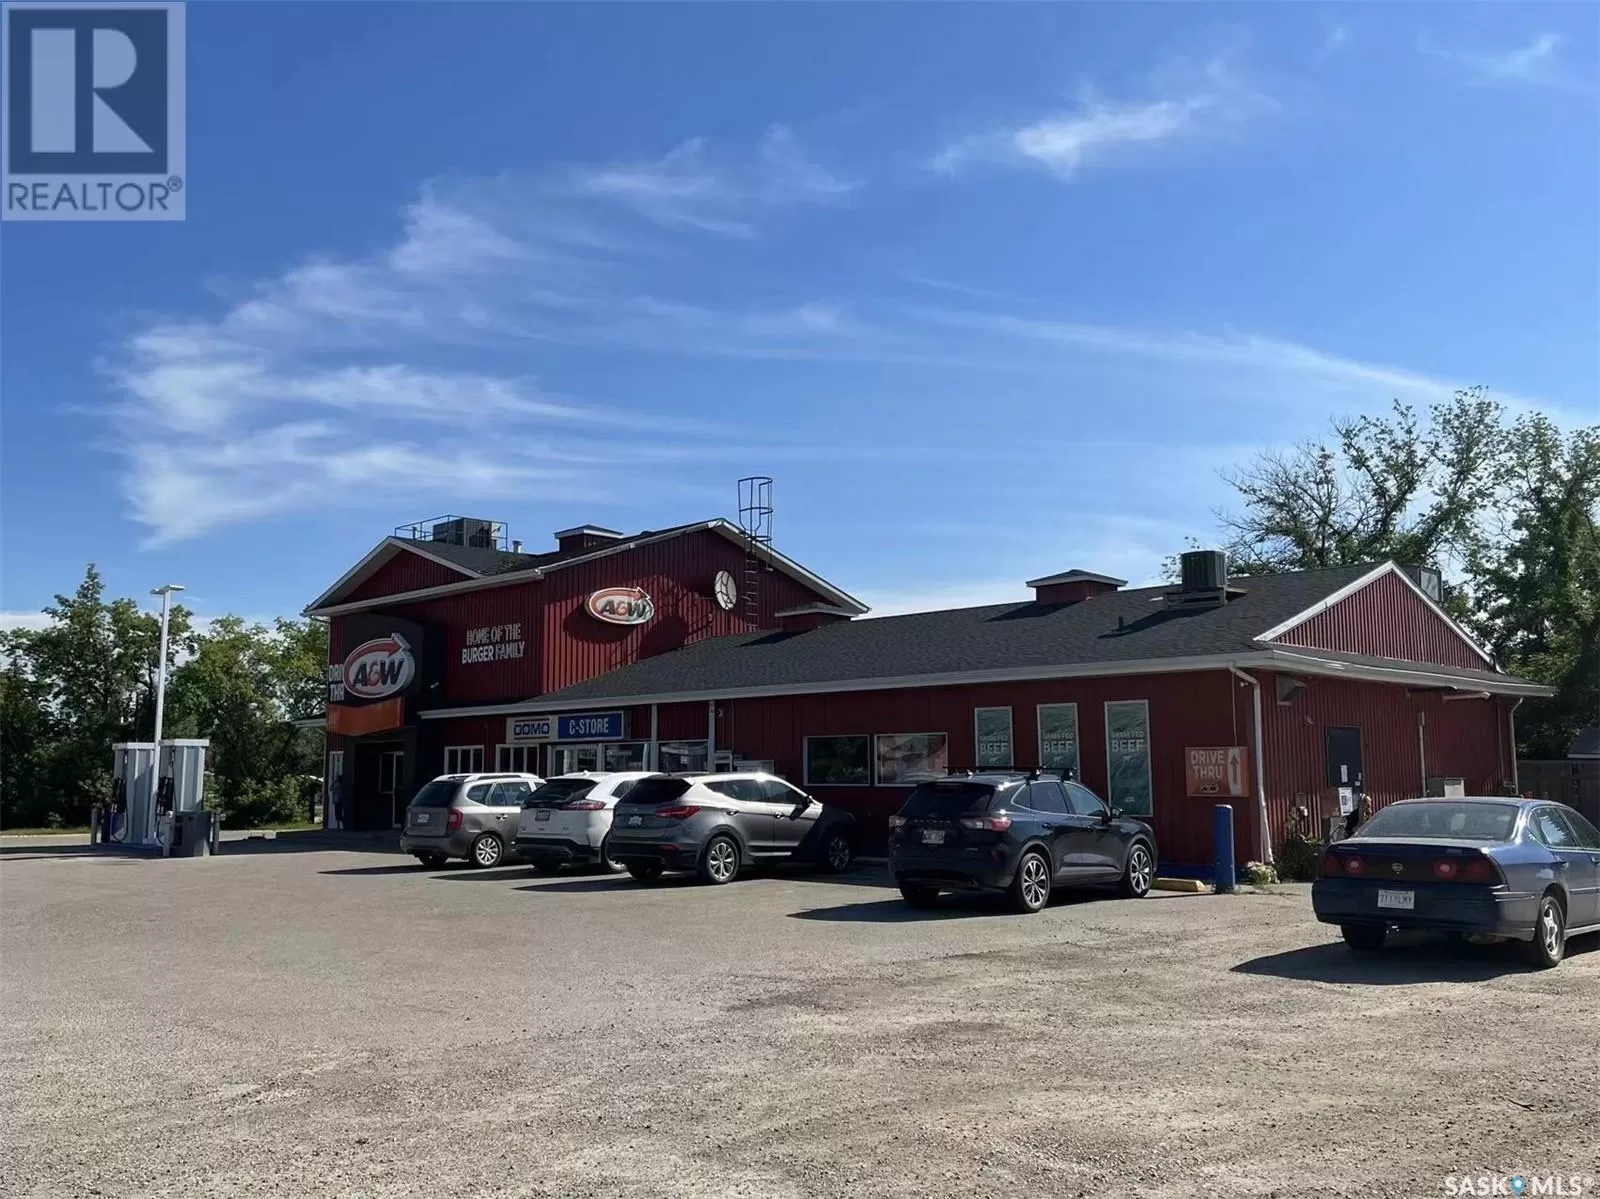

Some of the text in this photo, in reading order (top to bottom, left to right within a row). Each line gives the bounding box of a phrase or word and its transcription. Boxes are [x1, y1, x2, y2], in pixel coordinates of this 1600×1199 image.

[600, 599, 647, 617] A&W
[466, 622, 522, 646] HOME OF THE
[461, 640, 525, 665] BURGER FAMILY
[352, 657, 406, 688] A&W
[330, 684, 345, 702] THR
[513, 722, 551, 736] DOMO
[569, 717, 609, 735] C-STORE
[979, 742, 1009, 754] BEEF
[1043, 740, 1073, 753] BEEF
[1112, 739, 1145, 753] BEEF
[1191, 750, 1224, 765] DRIVE
[1193, 765, 1223, 780] THRU
